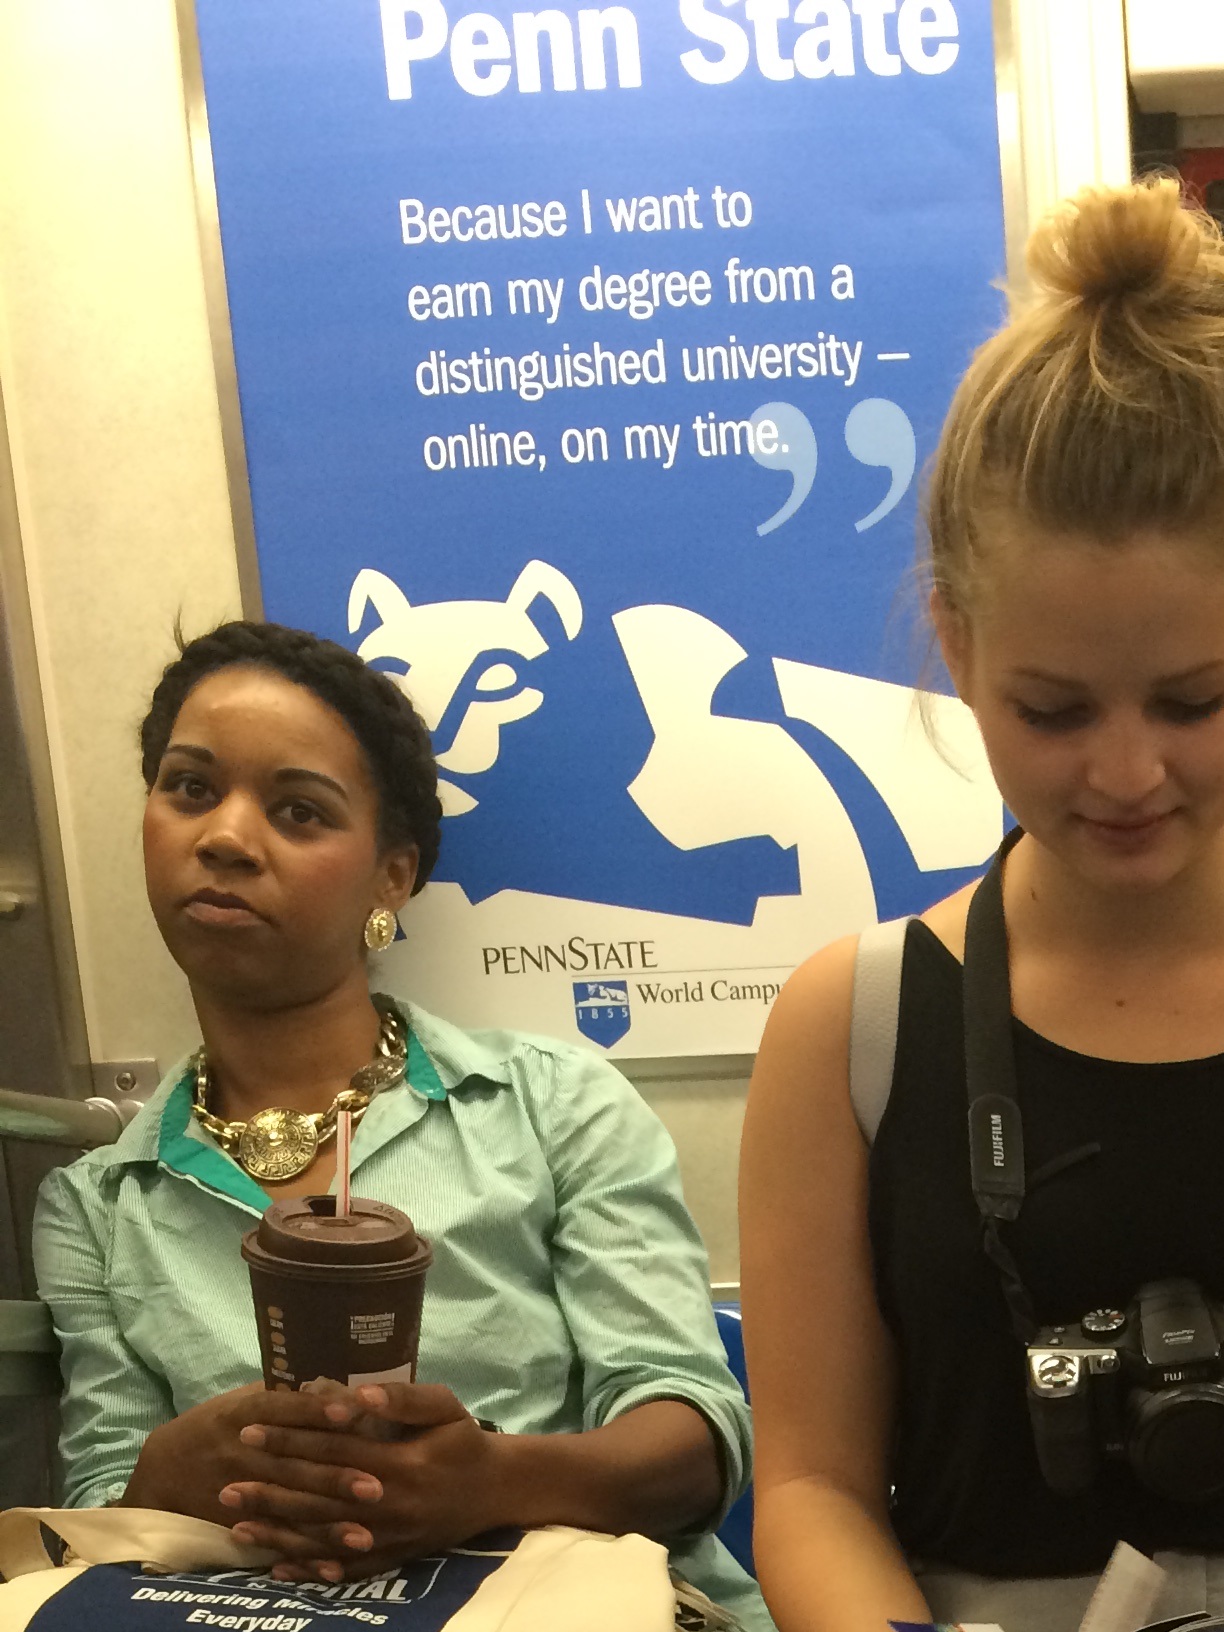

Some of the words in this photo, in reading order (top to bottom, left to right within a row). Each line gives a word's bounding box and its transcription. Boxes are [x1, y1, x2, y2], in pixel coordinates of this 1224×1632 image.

[380, 0, 642, 100] Penn
[678, 0, 960, 85] State
[399, 198, 568, 245] Because
[581, 189, 593, 234] I
[605, 186, 703, 233] want
[711, 185, 754, 229] to
[408, 279, 492, 320] earn
[508, 278, 565, 324] my
[579, 265, 712, 320] degree
[724, 257, 815, 303] from
[831, 264, 856, 300] a
[416, 339, 667, 401] distinguished
[682, 332, 863, 387] university
[424, 423, 546, 472] online,
[562, 427, 609, 463] on
[625, 424, 680, 468] my
[692, 412, 790, 457] time.
[636, 981, 704, 1004] World
[710, 980, 781, 1005] Camp
[990, 1113, 1005, 1168] FUJIFILM
[130, 1586, 270, 1610] Delivering
